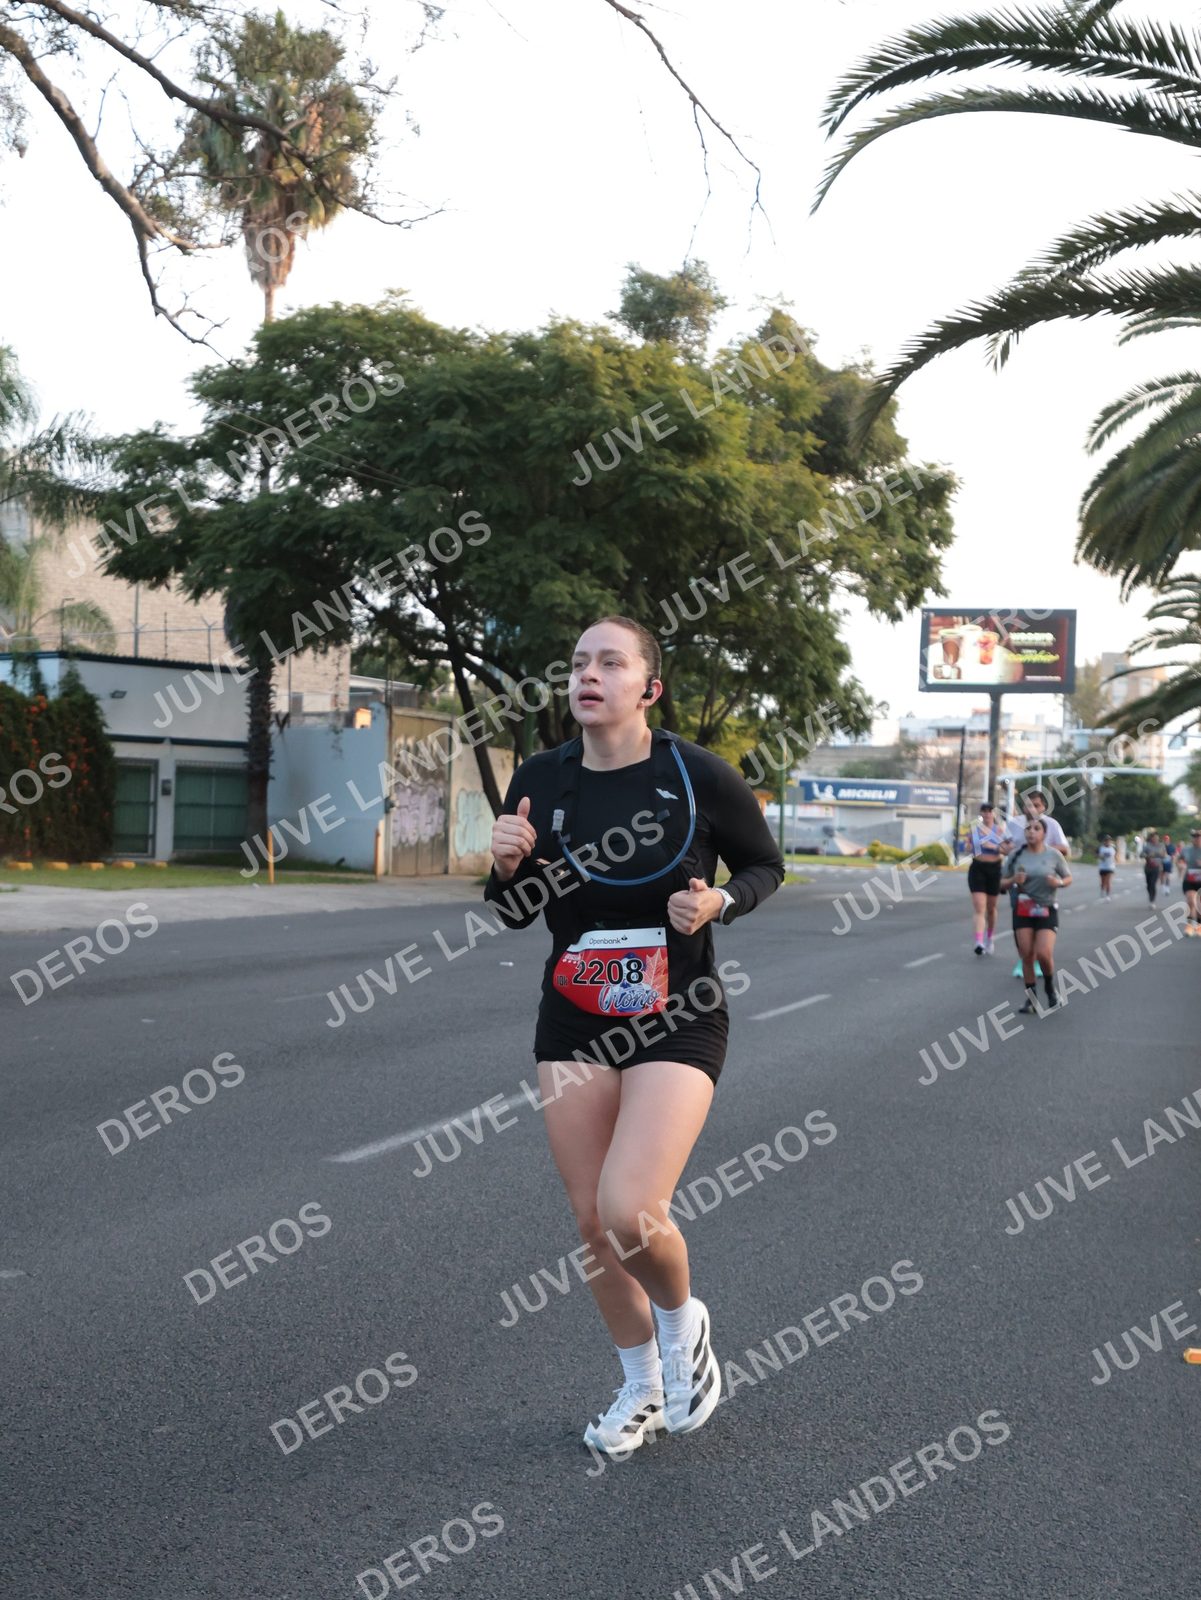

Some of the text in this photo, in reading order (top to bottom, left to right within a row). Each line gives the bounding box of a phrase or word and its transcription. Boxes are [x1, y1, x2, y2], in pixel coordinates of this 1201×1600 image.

[837, 788, 898, 800] MICHELIN
[588, 938, 621, 946] Openbank
[572, 958, 644, 986] 2208
